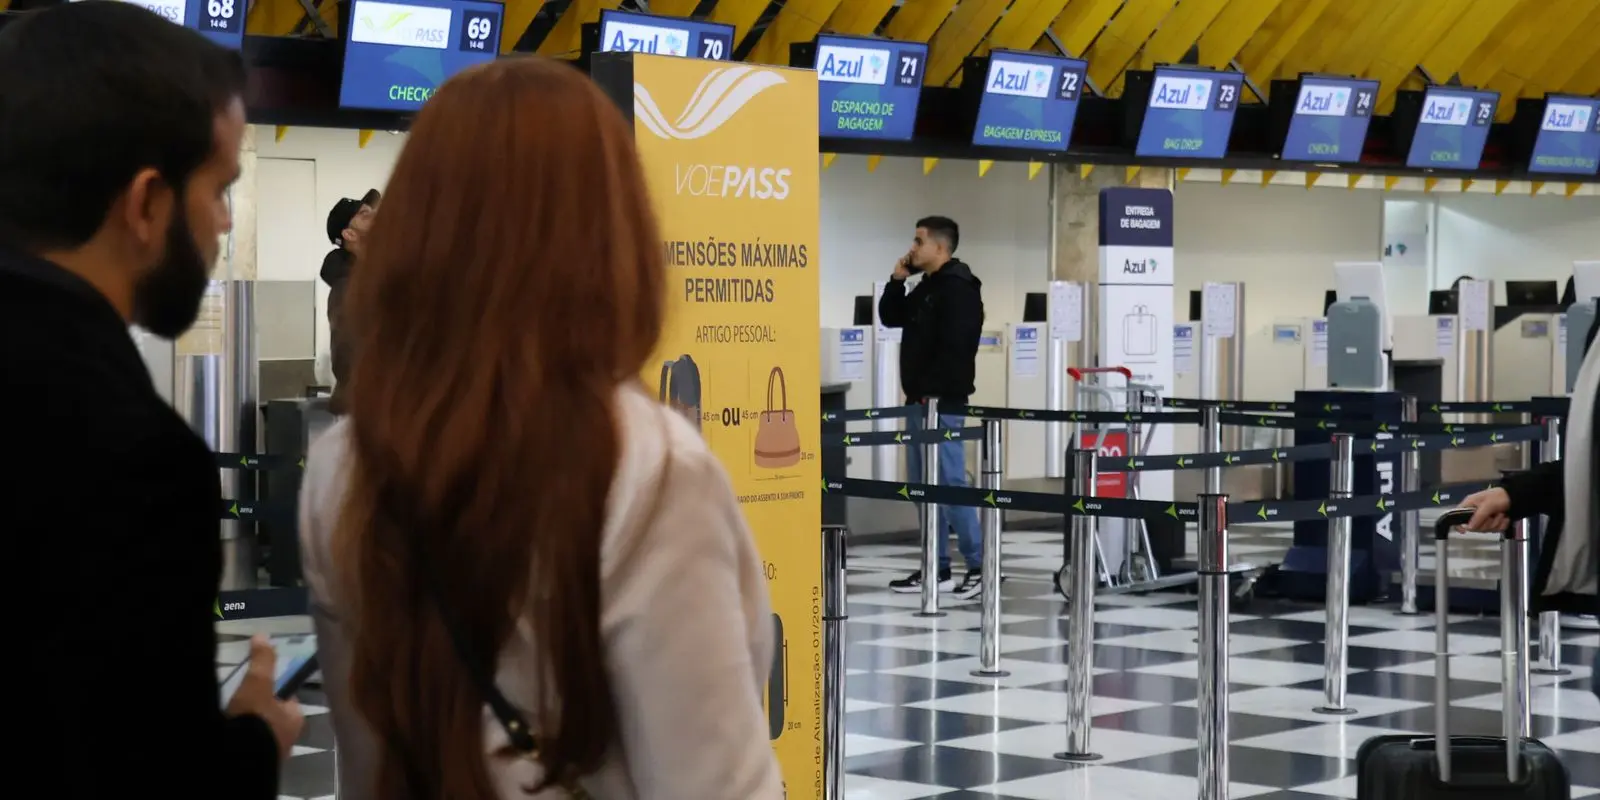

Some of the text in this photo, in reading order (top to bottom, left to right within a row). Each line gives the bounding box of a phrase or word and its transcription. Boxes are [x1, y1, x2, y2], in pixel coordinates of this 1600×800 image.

[208, 0, 235, 18] 68
[467, 17, 491, 40] 69
[611, 30, 658, 54] Azul
[703, 39, 723, 60] 70
[822, 53, 864, 78] Azul
[901, 57, 917, 76] 71
[992, 67, 1030, 91] Azul
[1062, 72, 1078, 91] 72
[389, 85, 438, 102] CHECK-
[1155, 83, 1191, 105] Azul
[1220, 85, 1235, 102] 73
[1301, 90, 1333, 111] Azul
[1357, 92, 1372, 109] 74
[831, 100, 895, 116] DESPACHO DE
[1426, 101, 1455, 121] Azul
[1478, 102, 1492, 119] 75
[837, 117, 884, 131] BAGAGEM
[1547, 108, 1576, 128] Azul
[983, 125, 1062, 143] BAGAGEM EXPRESSA
[1163, 138, 1203, 151] BAG DROP
[675, 163, 792, 200] VOEPASS
[1125, 205, 1155, 217] ENTREGA
[1120, 218, 1161, 230] DE BAGAGEM
[663, 236, 808, 268] MENSÕES MÁXIMAS
[1123, 258, 1146, 275] Azul
[685, 278, 774, 303] PERMITIDAS
[696, 325, 776, 344] ARTIGO PESSOAL:
[703, 412, 720, 421] 45 cm
[722, 407, 740, 427] ou
[742, 410, 758, 420] 45 cm
[828, 482, 843, 490] aena
[910, 489, 925, 497] aena
[996, 496, 1012, 504] aena
[1376, 462, 1393, 541] Aul
[224, 601, 246, 611] aena
[814, 653, 822, 741] Atualização
[814, 746, 821, 765] de
